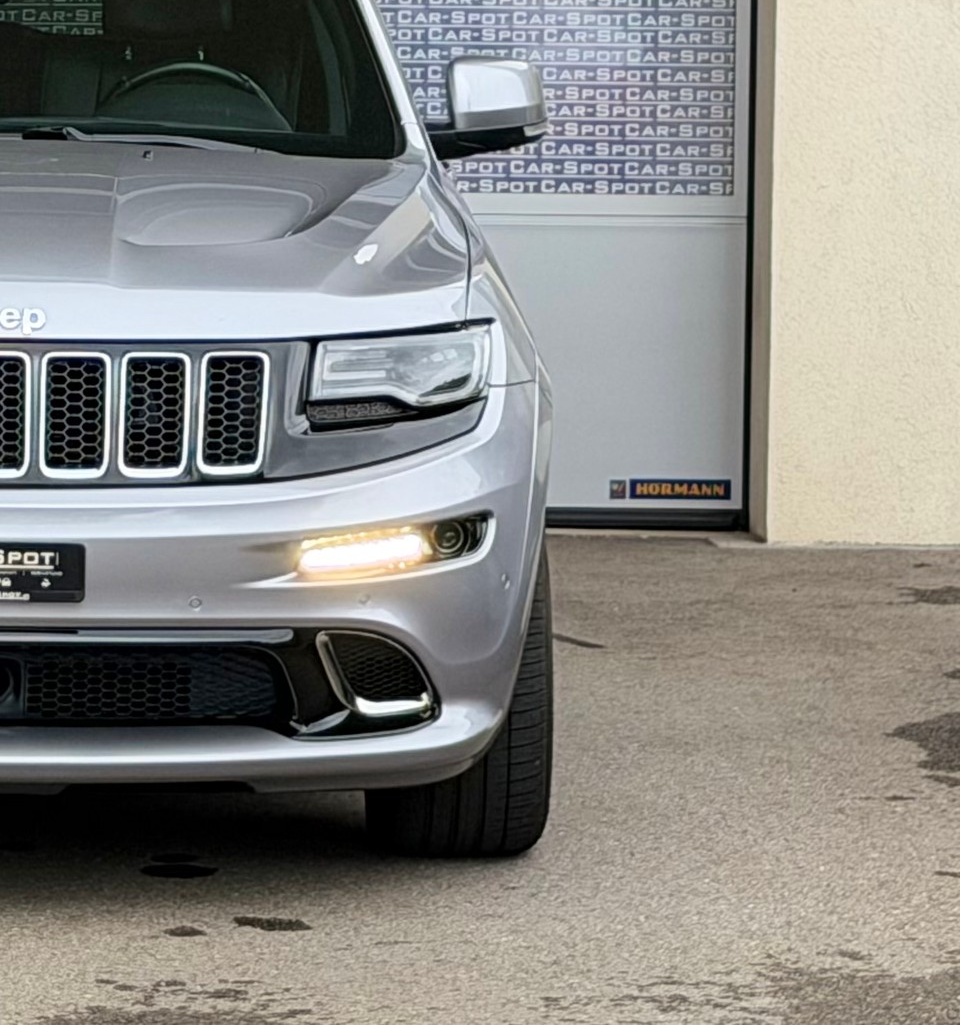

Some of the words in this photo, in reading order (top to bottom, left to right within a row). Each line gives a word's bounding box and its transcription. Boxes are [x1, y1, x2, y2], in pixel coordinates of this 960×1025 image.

[397, 9, 510, 24] CAR-SPOT
[512, 11, 624, 25] CAR-SPOT
[428, 27, 540, 41] CAR-SPOT
[543, 29, 655, 43] CAR-SPOT
[542, 67, 655, 81] CAR-SPOT
[541, 141, 654, 155] CAR-SPOT
[510, 160, 622, 174] CAR-SPOT
[541, 179, 653, 194] CAR-SPOT
